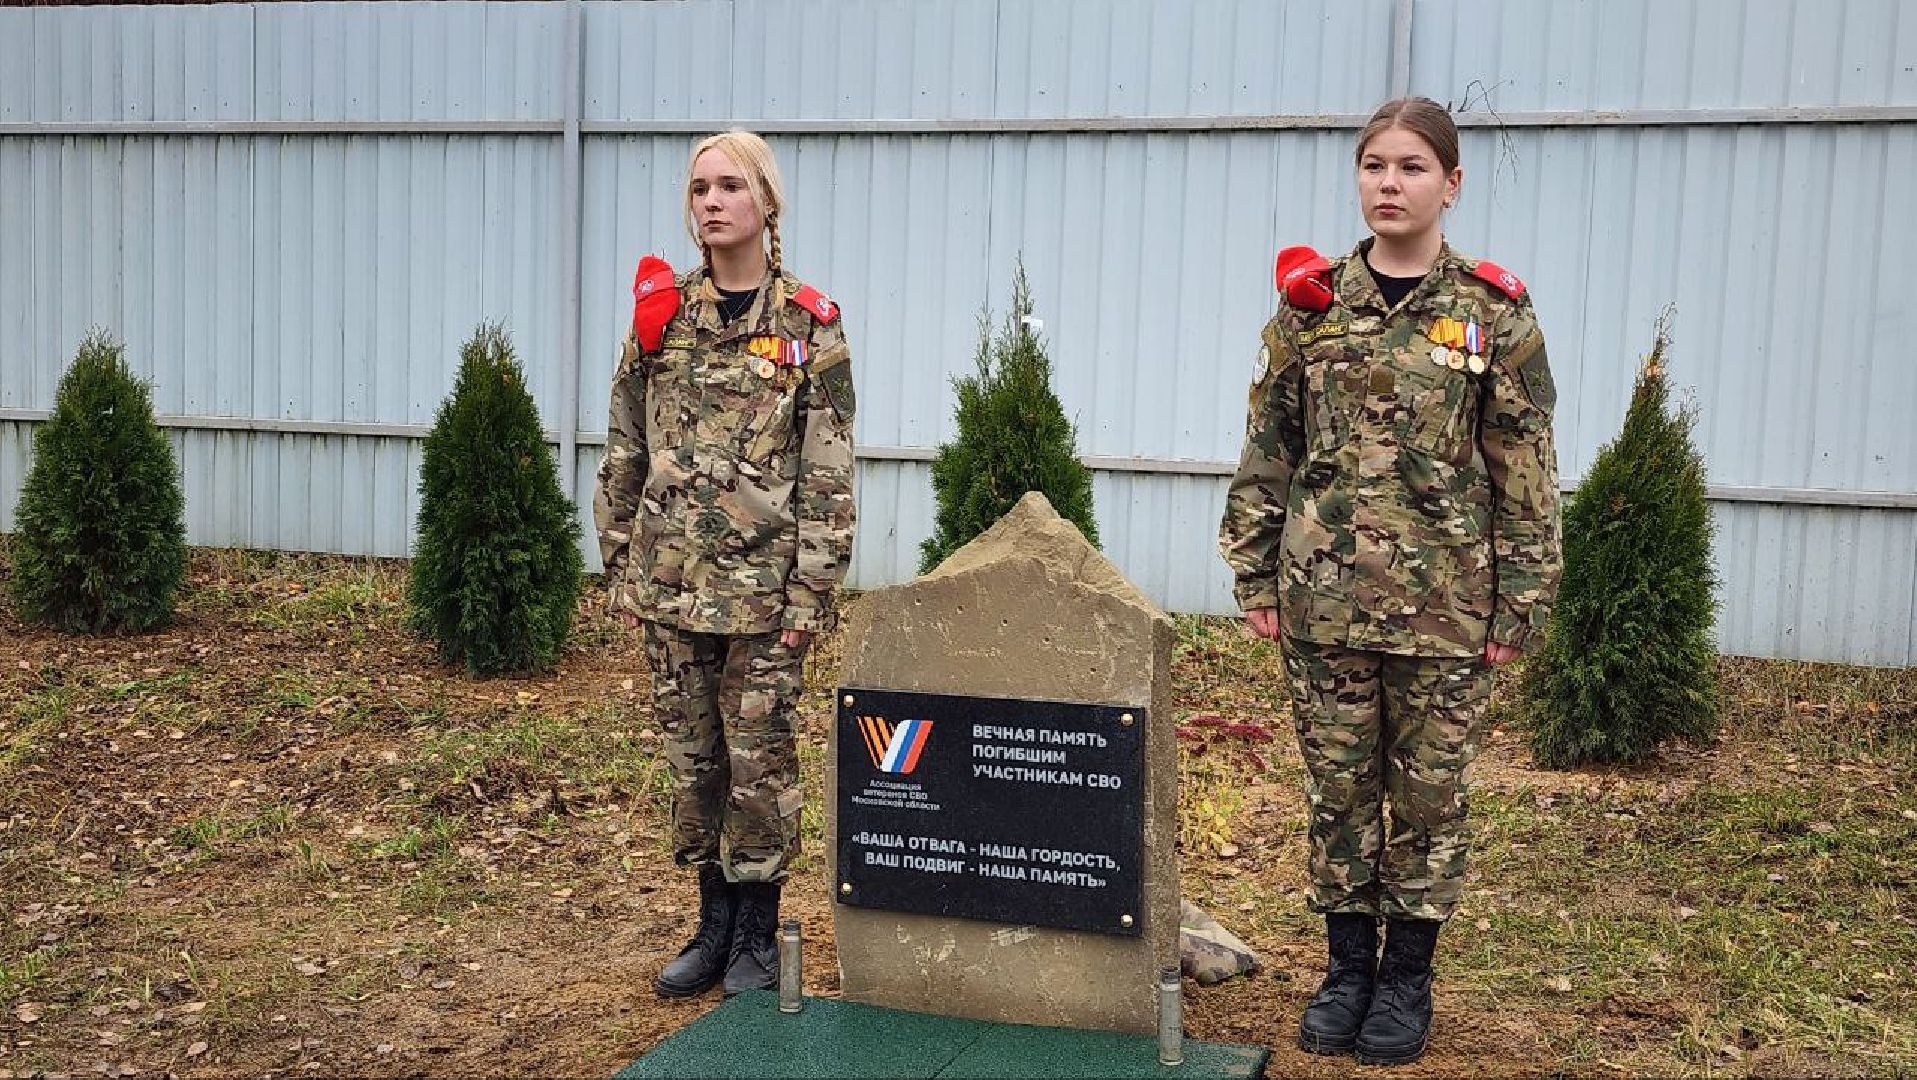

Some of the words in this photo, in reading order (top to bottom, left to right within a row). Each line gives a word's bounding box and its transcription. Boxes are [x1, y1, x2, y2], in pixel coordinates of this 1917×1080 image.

[973, 724, 1034, 741] ВЕЧНАЯ
[1040, 730, 1106, 747] ПАМЯТЬ
[973, 744, 1066, 763] ПОГИБШИМ
[869, 780, 921, 790] Ассоциация
[973, 765, 1082, 786] УЧАСТНИКАМ
[1087, 774, 1121, 789] СВО
[851, 795, 904, 807] Московской
[905, 800, 941, 811] области
[909, 791, 928, 800] СВО
[852, 832, 904, 847] «ВАША
[908, 837, 966, 853] ОТВАГА
[980, 843, 1027, 860] НАША
[1031, 849, 1120, 872] ГОРДОСТЬ,
[865, 852, 898, 867] ВАШ
[904, 856, 965, 873] ПОДВИГ
[979, 864, 1027, 880] НАША
[1031, 868, 1106, 887] ПАМЯТЬ»
